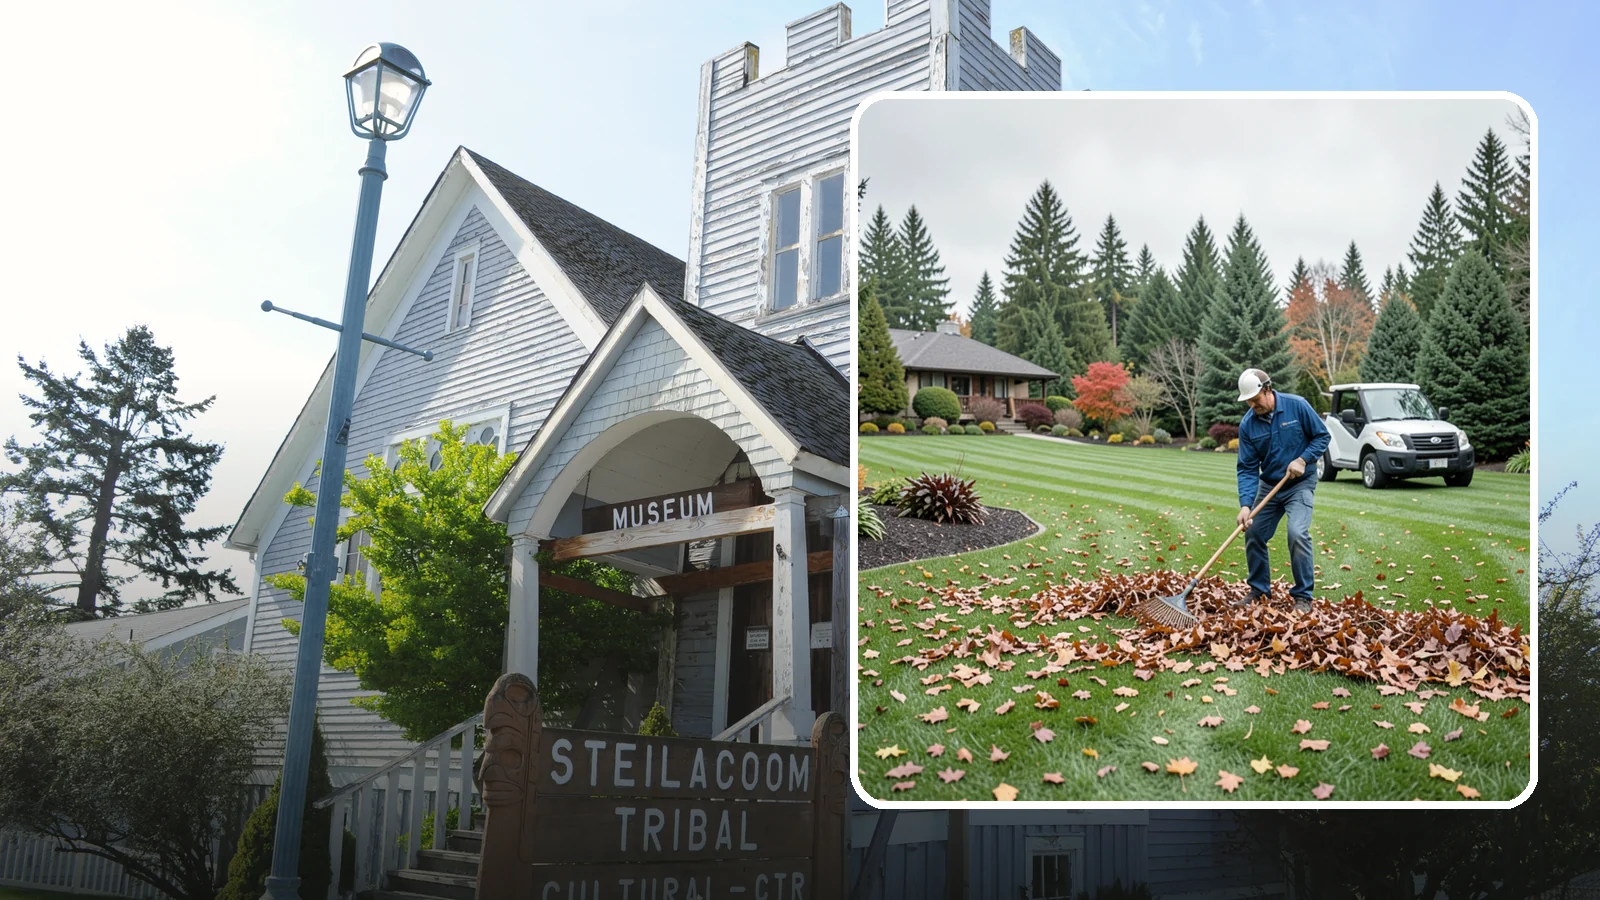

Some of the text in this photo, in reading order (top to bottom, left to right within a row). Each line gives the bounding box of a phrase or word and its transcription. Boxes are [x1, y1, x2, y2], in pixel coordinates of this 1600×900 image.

[613, 491, 713, 530] MUSEUM
[550, 738, 809, 792] STEILACOOM
[615, 806, 758, 851] TRIBAL
